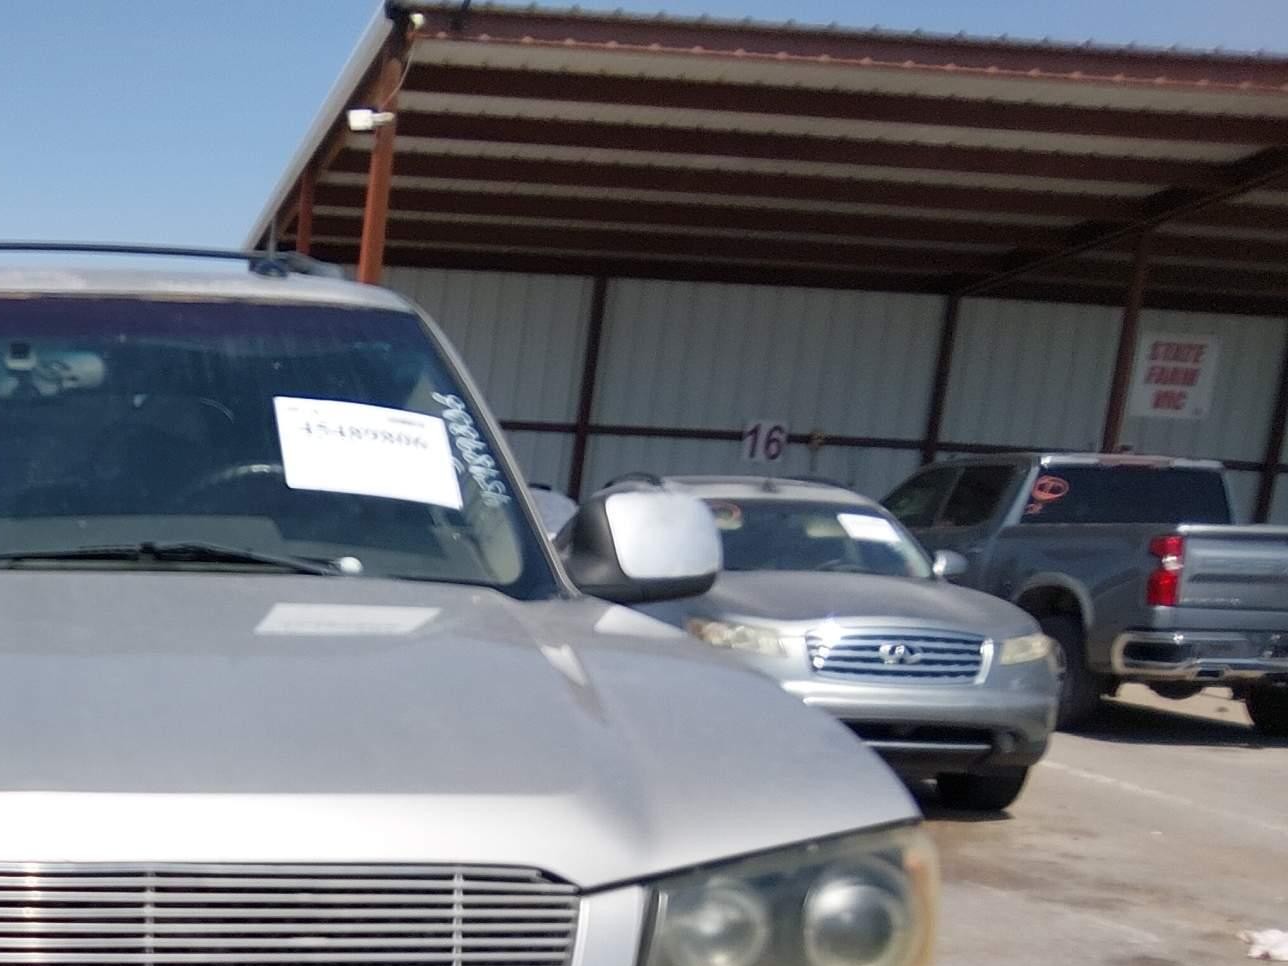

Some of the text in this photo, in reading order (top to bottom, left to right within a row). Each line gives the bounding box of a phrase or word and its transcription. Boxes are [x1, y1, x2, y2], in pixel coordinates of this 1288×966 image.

[1149, 341, 1206, 362] STATE
[1145, 366, 1200, 386] FARM
[746, 423, 785, 460] 16
